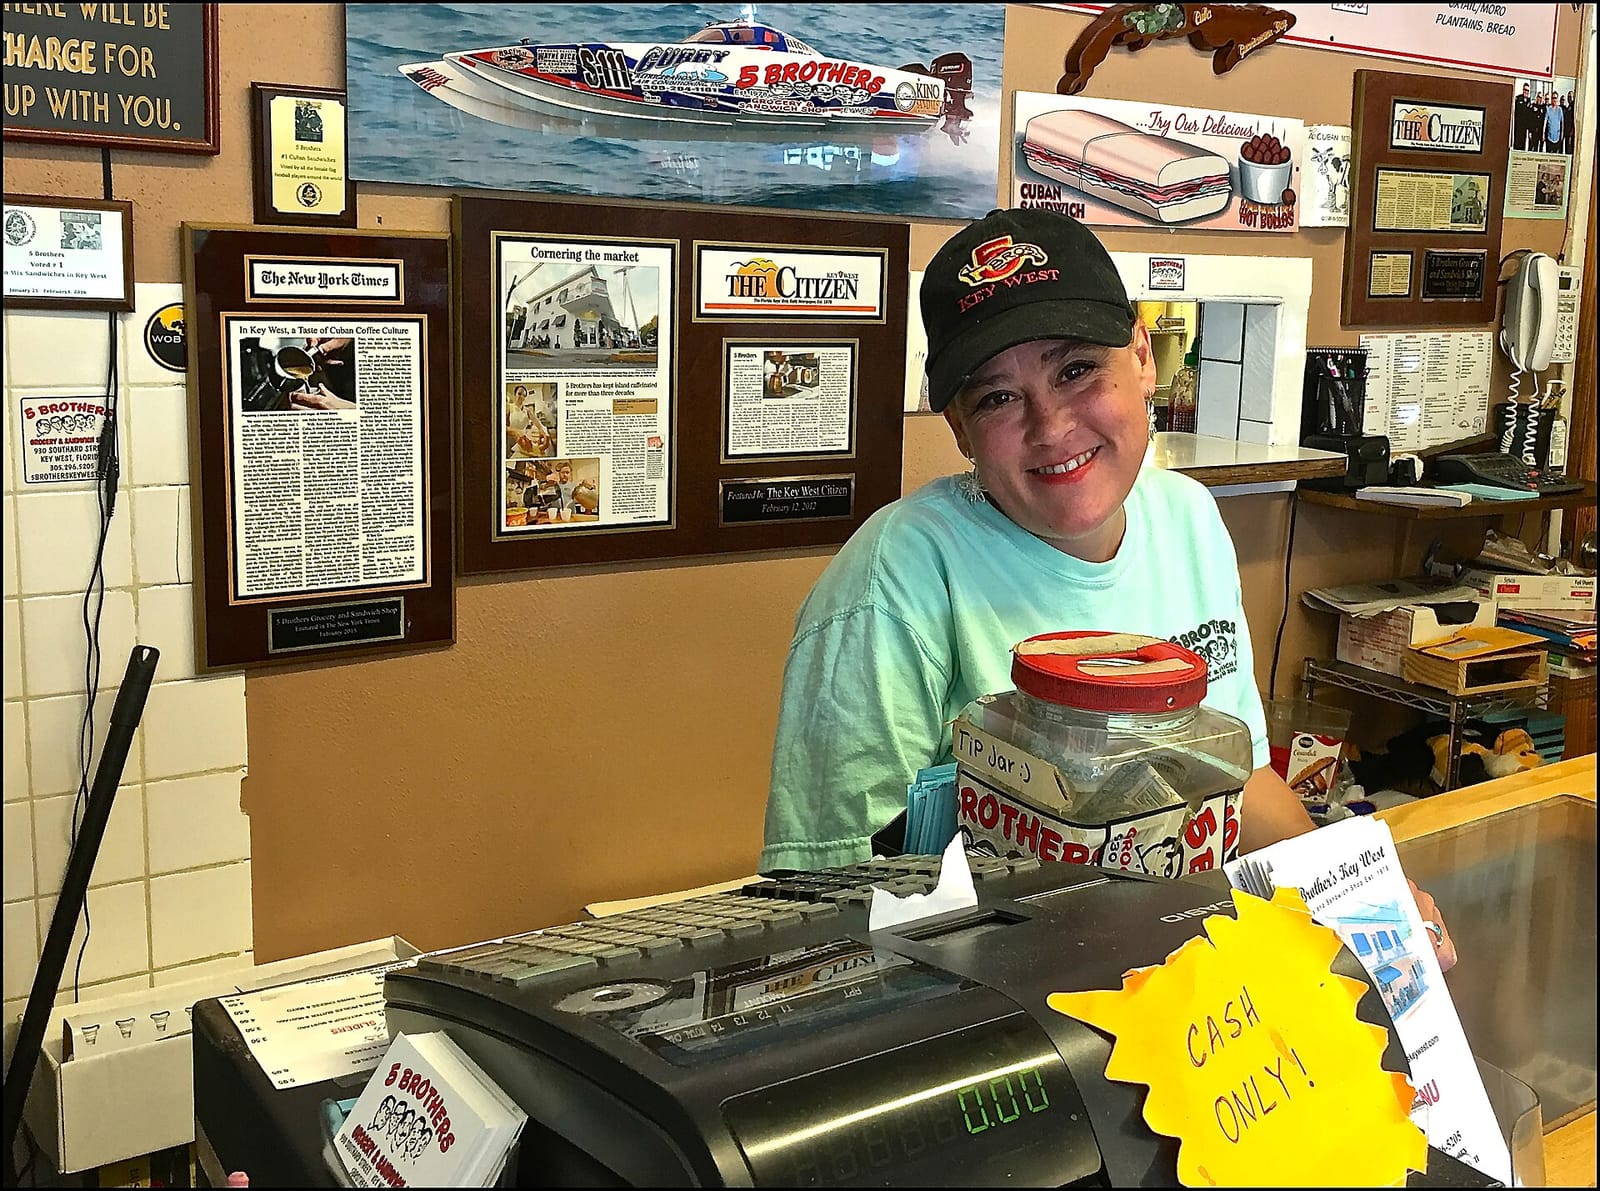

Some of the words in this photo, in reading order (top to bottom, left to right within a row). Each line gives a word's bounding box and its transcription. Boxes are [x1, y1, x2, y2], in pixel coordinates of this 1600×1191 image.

[144, 3, 170, 30] BE
[1435, 14, 1484, 33] PLANTAINS,
[1486, 22, 1516, 36] BREAD
[104, 42, 157, 79] FOR
[635, 46, 731, 73] CURRY
[736, 65, 759, 89] 5
[764, 61, 885, 94] BROTHERS
[916, 83, 940, 99] KINO
[4, 84, 36, 117] UP
[45, 87, 109, 124] WITH
[118, 94, 181, 131] YOU.
[1174, 113, 1199, 134] Our
[1202, 115, 1255, 137] Delicious
[1395, 120, 1422, 141] THE
[1020, 183, 1062, 201] CUBAN
[1239, 205, 1257, 227] HOT
[530, 246, 582, 263] Cornering
[585, 249, 601, 261] the
[603, 250, 640, 263] market
[261, 270, 286, 287] The
[287, 271, 316, 286] New
[318, 272, 350, 289] York
[351, 272, 389, 287] Times
[726, 274, 767, 298] THE
[776, 265, 860, 300] CITIZEN
[957, 285, 996, 313] KEY
[1002, 269, 1060, 288] WEST
[151, 335, 182, 344] WOB
[239, 326, 248, 334] In
[250, 326, 266, 336] Key
[268, 326, 290, 336] West,
[298, 326, 318, 335] Taste
[320, 326, 329, 335] of
[330, 327, 354, 335] Cuban
[355, 327, 380, 335] Coffee
[382, 327, 409, 335] Culture
[24, 407, 36, 420] 5
[48, 445, 83, 454] SOUTHARD
[766, 487, 783, 498] The
[783, 486, 800, 498] Key
[801, 485, 820, 497] West
[821, 484, 848, 496] Citizen
[762, 504, 790, 513] February
[381, 607, 398, 615] Shop
[988, 740, 1016, 774] Jar
[958, 786, 1099, 866] ROTHER
[1299, 869, 1338, 903] Brother's
[1338, 862, 1360, 882] Key
[1358, 845, 1386, 868] West
[330, 1020, 377, 1035] SLIDERS
[1187, 985, 1261, 1068] CASH
[1406, 1035, 1440, 1063] skeywest.com
[957, 1068, 1050, 1135] 0.00
[1214, 1048, 1315, 1144] ONLY!
[1417, 1079, 1440, 1106] NU
[384, 1062, 402, 1087] 5
[399, 1067, 456, 1154] BROTHERS
